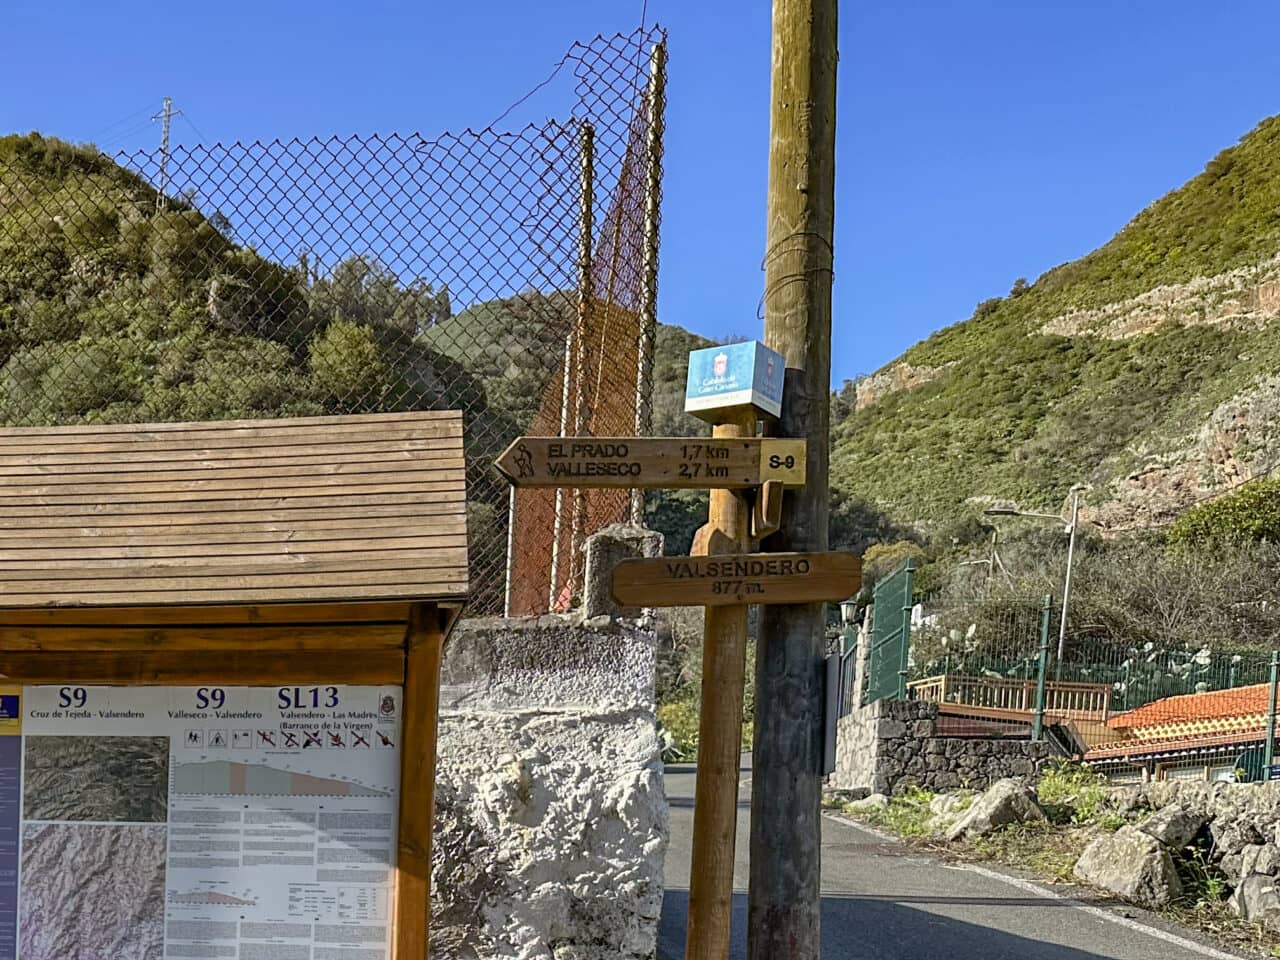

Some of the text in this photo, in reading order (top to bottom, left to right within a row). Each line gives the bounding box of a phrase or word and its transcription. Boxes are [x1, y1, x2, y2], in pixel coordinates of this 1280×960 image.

[547, 444, 729, 460] EL PRADO 1,7 km
[769, 455, 795, 469] S-9
[547, 462, 729, 479] VALLESECO 2,7 km
[666, 559, 810, 578] VALSENDERO
[712, 581, 743, 594] 877
[58, 687, 87, 709] S9
[196, 688, 225, 709] S9
[278, 687, 339, 709] SL13
[30, 710, 49, 719] Cruz
[52, 710, 62, 719] de
[65, 710, 91, 720] Tejeda
[99, 710, 145, 719] Valsendero
[168, 710, 208, 719] Valleseco
[215, 710, 262, 719] Valsendero
[280, 711, 325, 719] Valsendero
[332, 711, 346, 719] Las
[348, 711, 378, 719] Madres
[279, 721, 373, 731] (Barranco de la Virgen)
